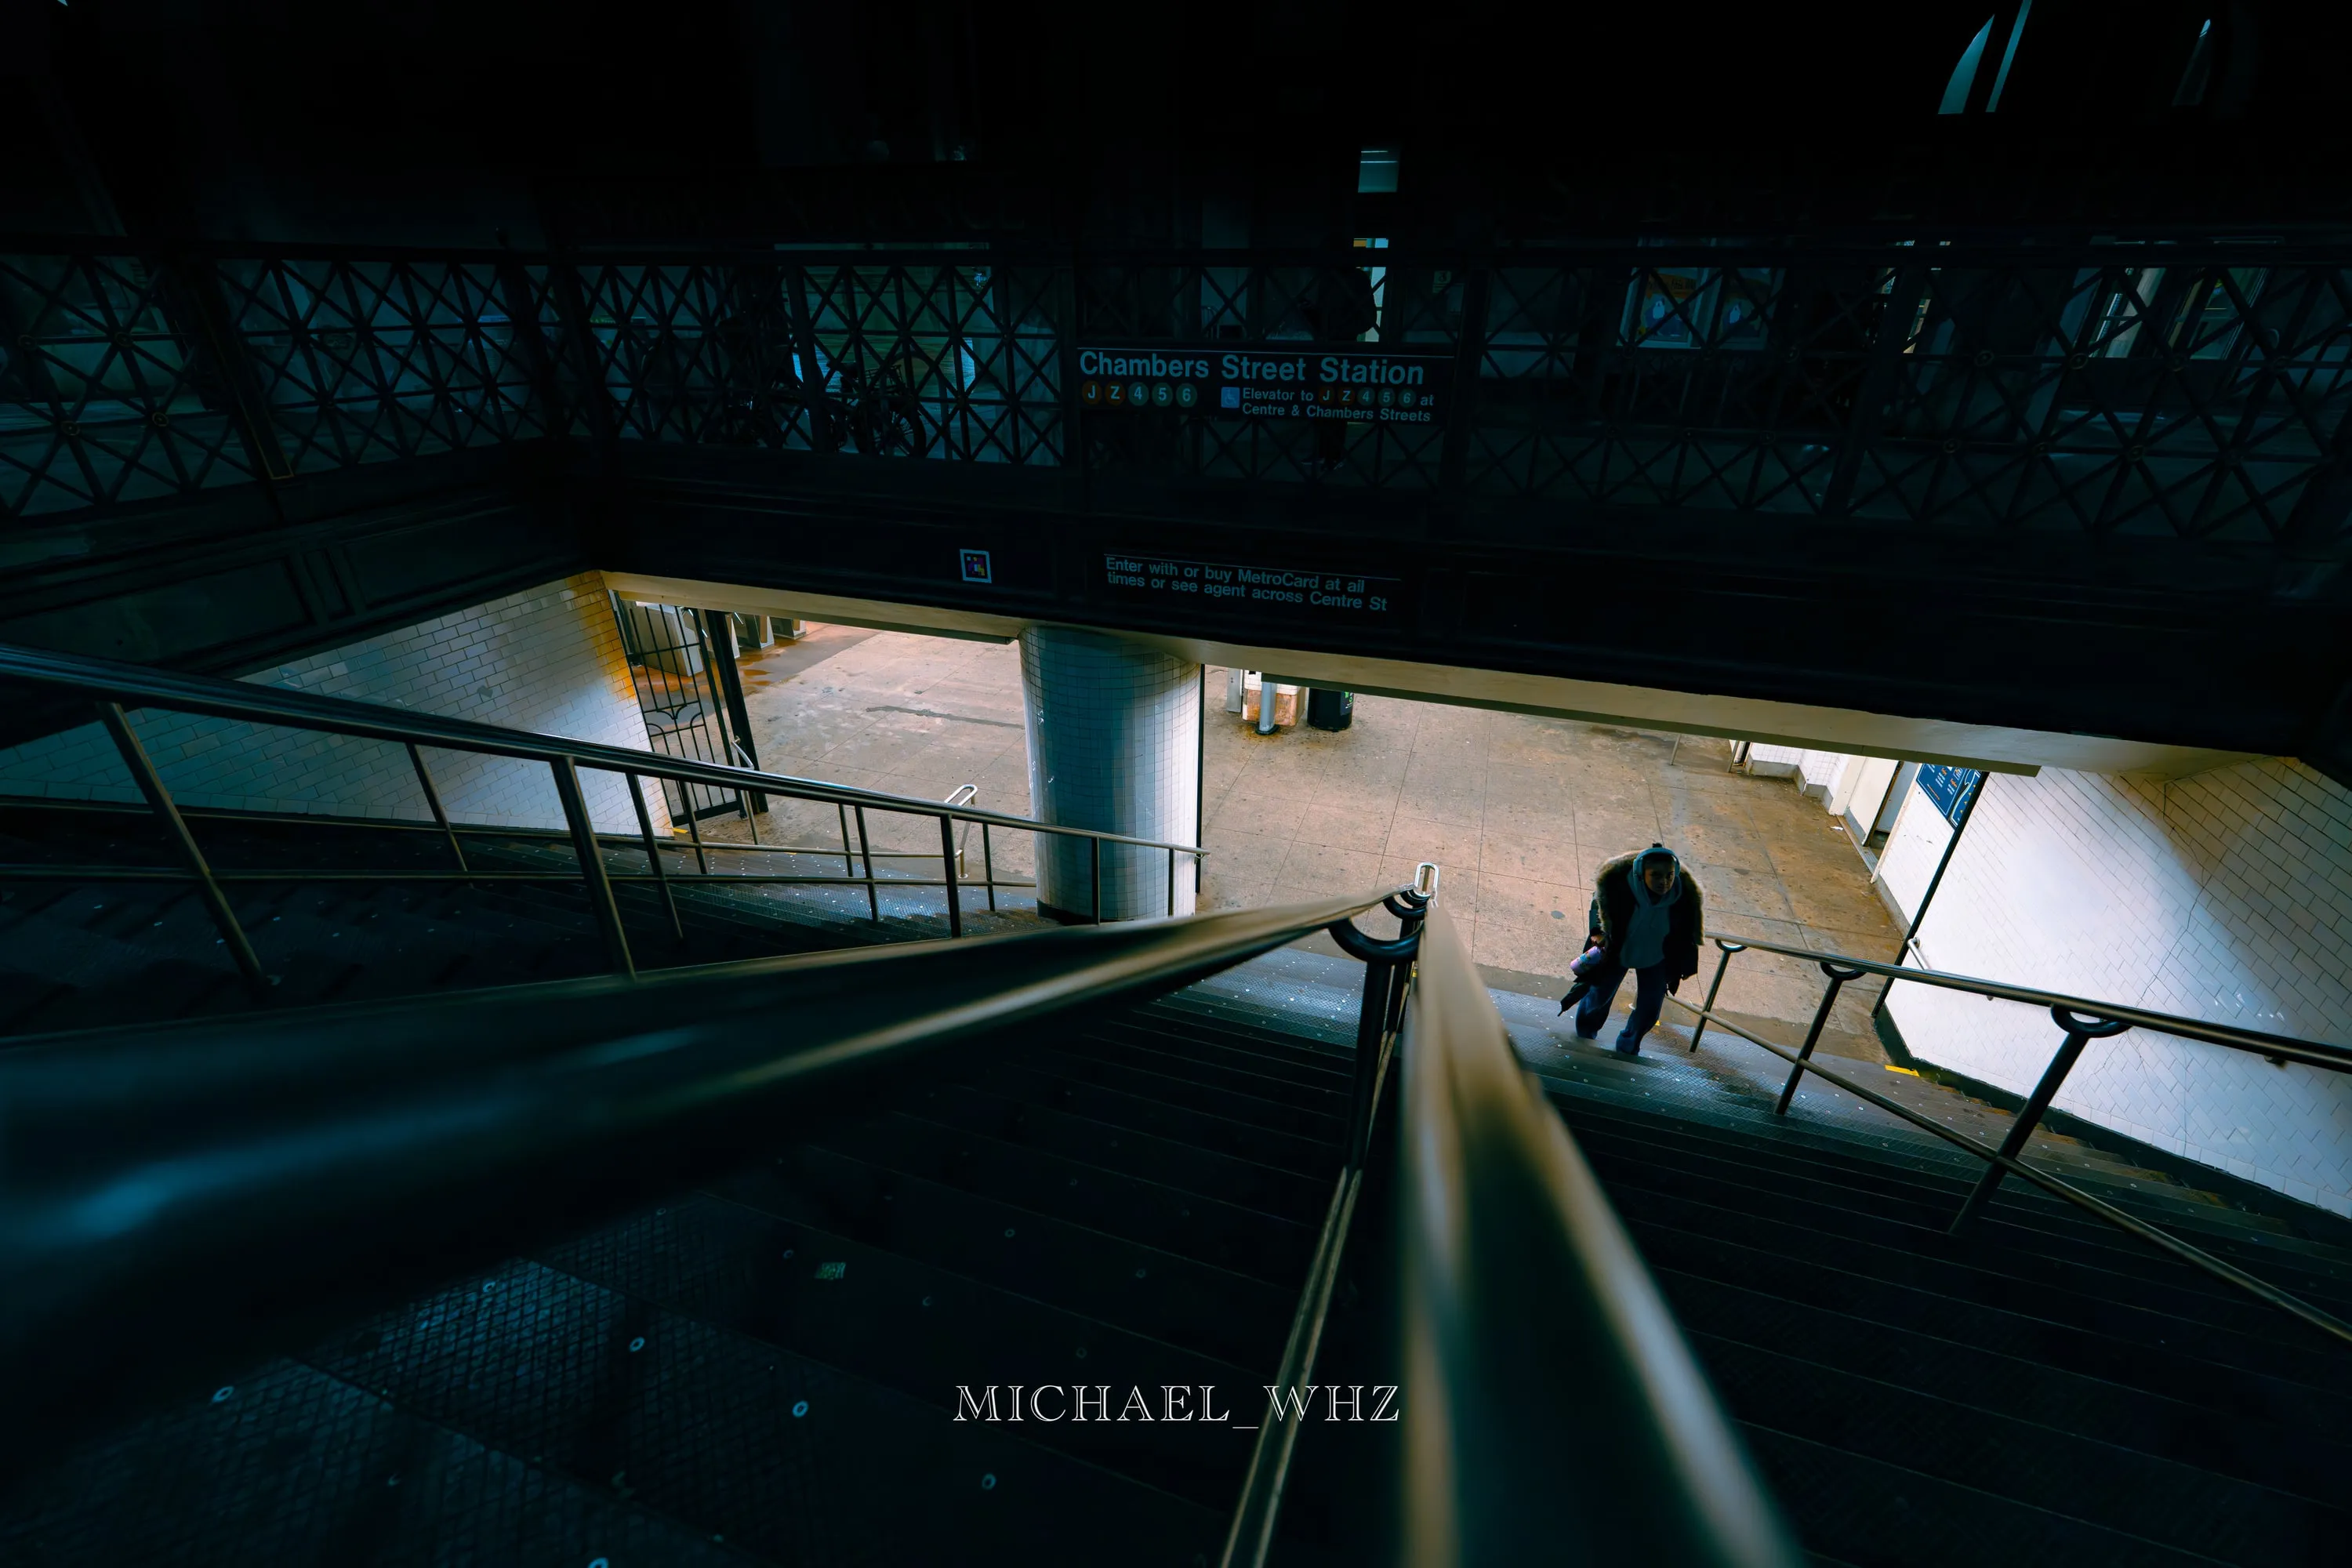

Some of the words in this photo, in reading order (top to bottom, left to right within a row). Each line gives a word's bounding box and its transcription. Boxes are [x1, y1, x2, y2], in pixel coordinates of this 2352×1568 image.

[1080, 350, 1209, 378] Chambers
[1221, 354, 1306, 380] Street
[1319, 357, 1424, 384] Station
[1087, 385, 1096, 399] J
[1110, 386, 1120, 400] Z
[1134, 387, 1142, 400] 4
[1158, 387, 1167, 401] 5
[1181, 388, 1192, 402] 6
[1242, 387, 1295, 401] Elevator
[1301, 388, 1314, 401] to
[1323, 390, 1330, 401] J
[1341, 390, 1351, 401] Z
[1362, 390, 1370, 402] 4
[1382, 391, 1391, 403] 5
[1403, 392, 1411, 404] 6
[1420, 394, 1434, 406] at
[1242, 403, 1285, 416] Centre
[1291, 405, 1300, 416] &
[1306, 405, 1374, 419] Chambers
[1380, 408, 1430, 422] Streets
[1106, 557, 1143, 572] Enter
[1149, 562, 1178, 576] with
[1184, 567, 1200, 578] or
[1205, 566, 1232, 583] buy
[1238, 568, 1319, 589] MetroCard
[1325, 578, 1341, 590] at
[1107, 572, 1145, 587] times
[1151, 578, 1166, 588] or
[1171, 580, 1198, 593] see
[1203, 583, 1246, 597] agent
[1251, 588, 1303, 603] across
[1309, 591, 1363, 608] Centre
[1369, 597, 1387, 611] St
